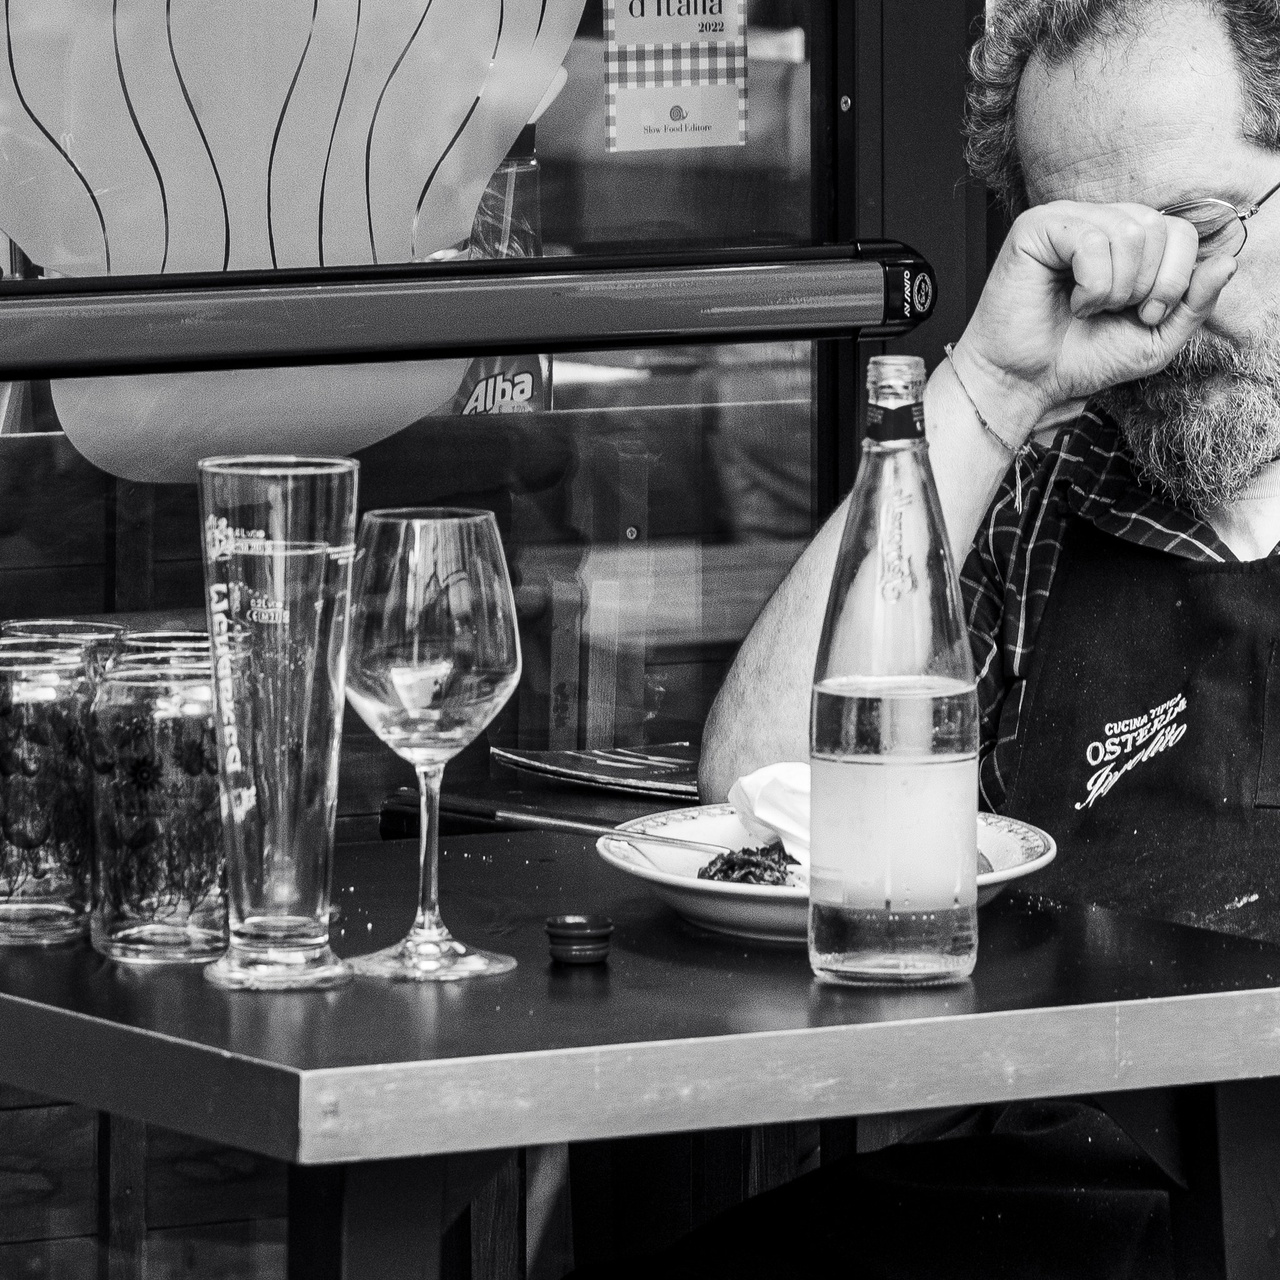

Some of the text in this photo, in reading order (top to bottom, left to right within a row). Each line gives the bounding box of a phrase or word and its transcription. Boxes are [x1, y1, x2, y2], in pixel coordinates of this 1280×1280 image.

[698, 21, 725, 33] 2022
[643, 122, 713, 134] Slow Food Editore
[461, 371, 534, 415] Alba
[1105, 714, 1148, 736] CUCINA
